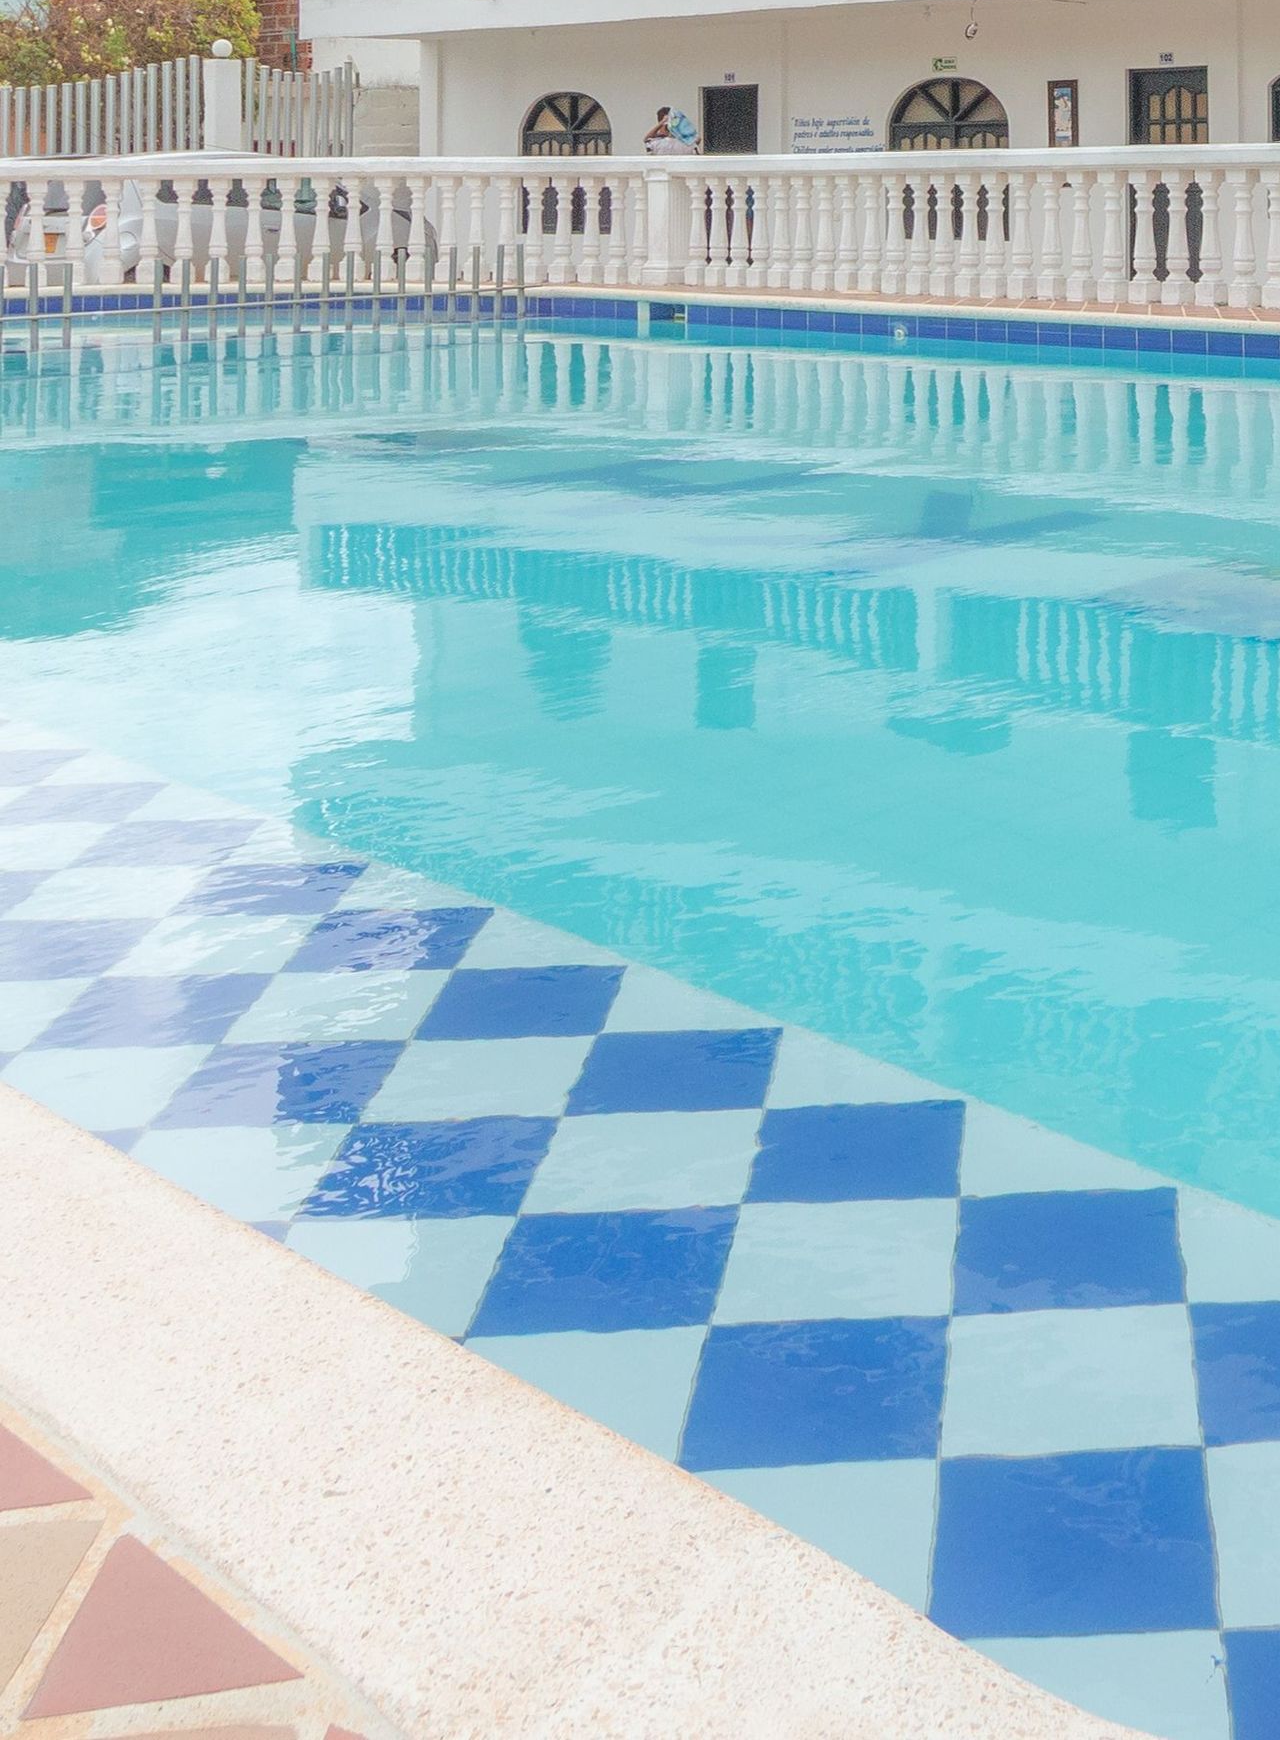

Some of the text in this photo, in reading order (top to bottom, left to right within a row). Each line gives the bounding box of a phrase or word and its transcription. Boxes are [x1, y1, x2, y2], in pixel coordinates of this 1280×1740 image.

[1160, 53, 1174, 63] 102
[862, 116, 871, 126] de
[793, 131, 813, 142] padres
